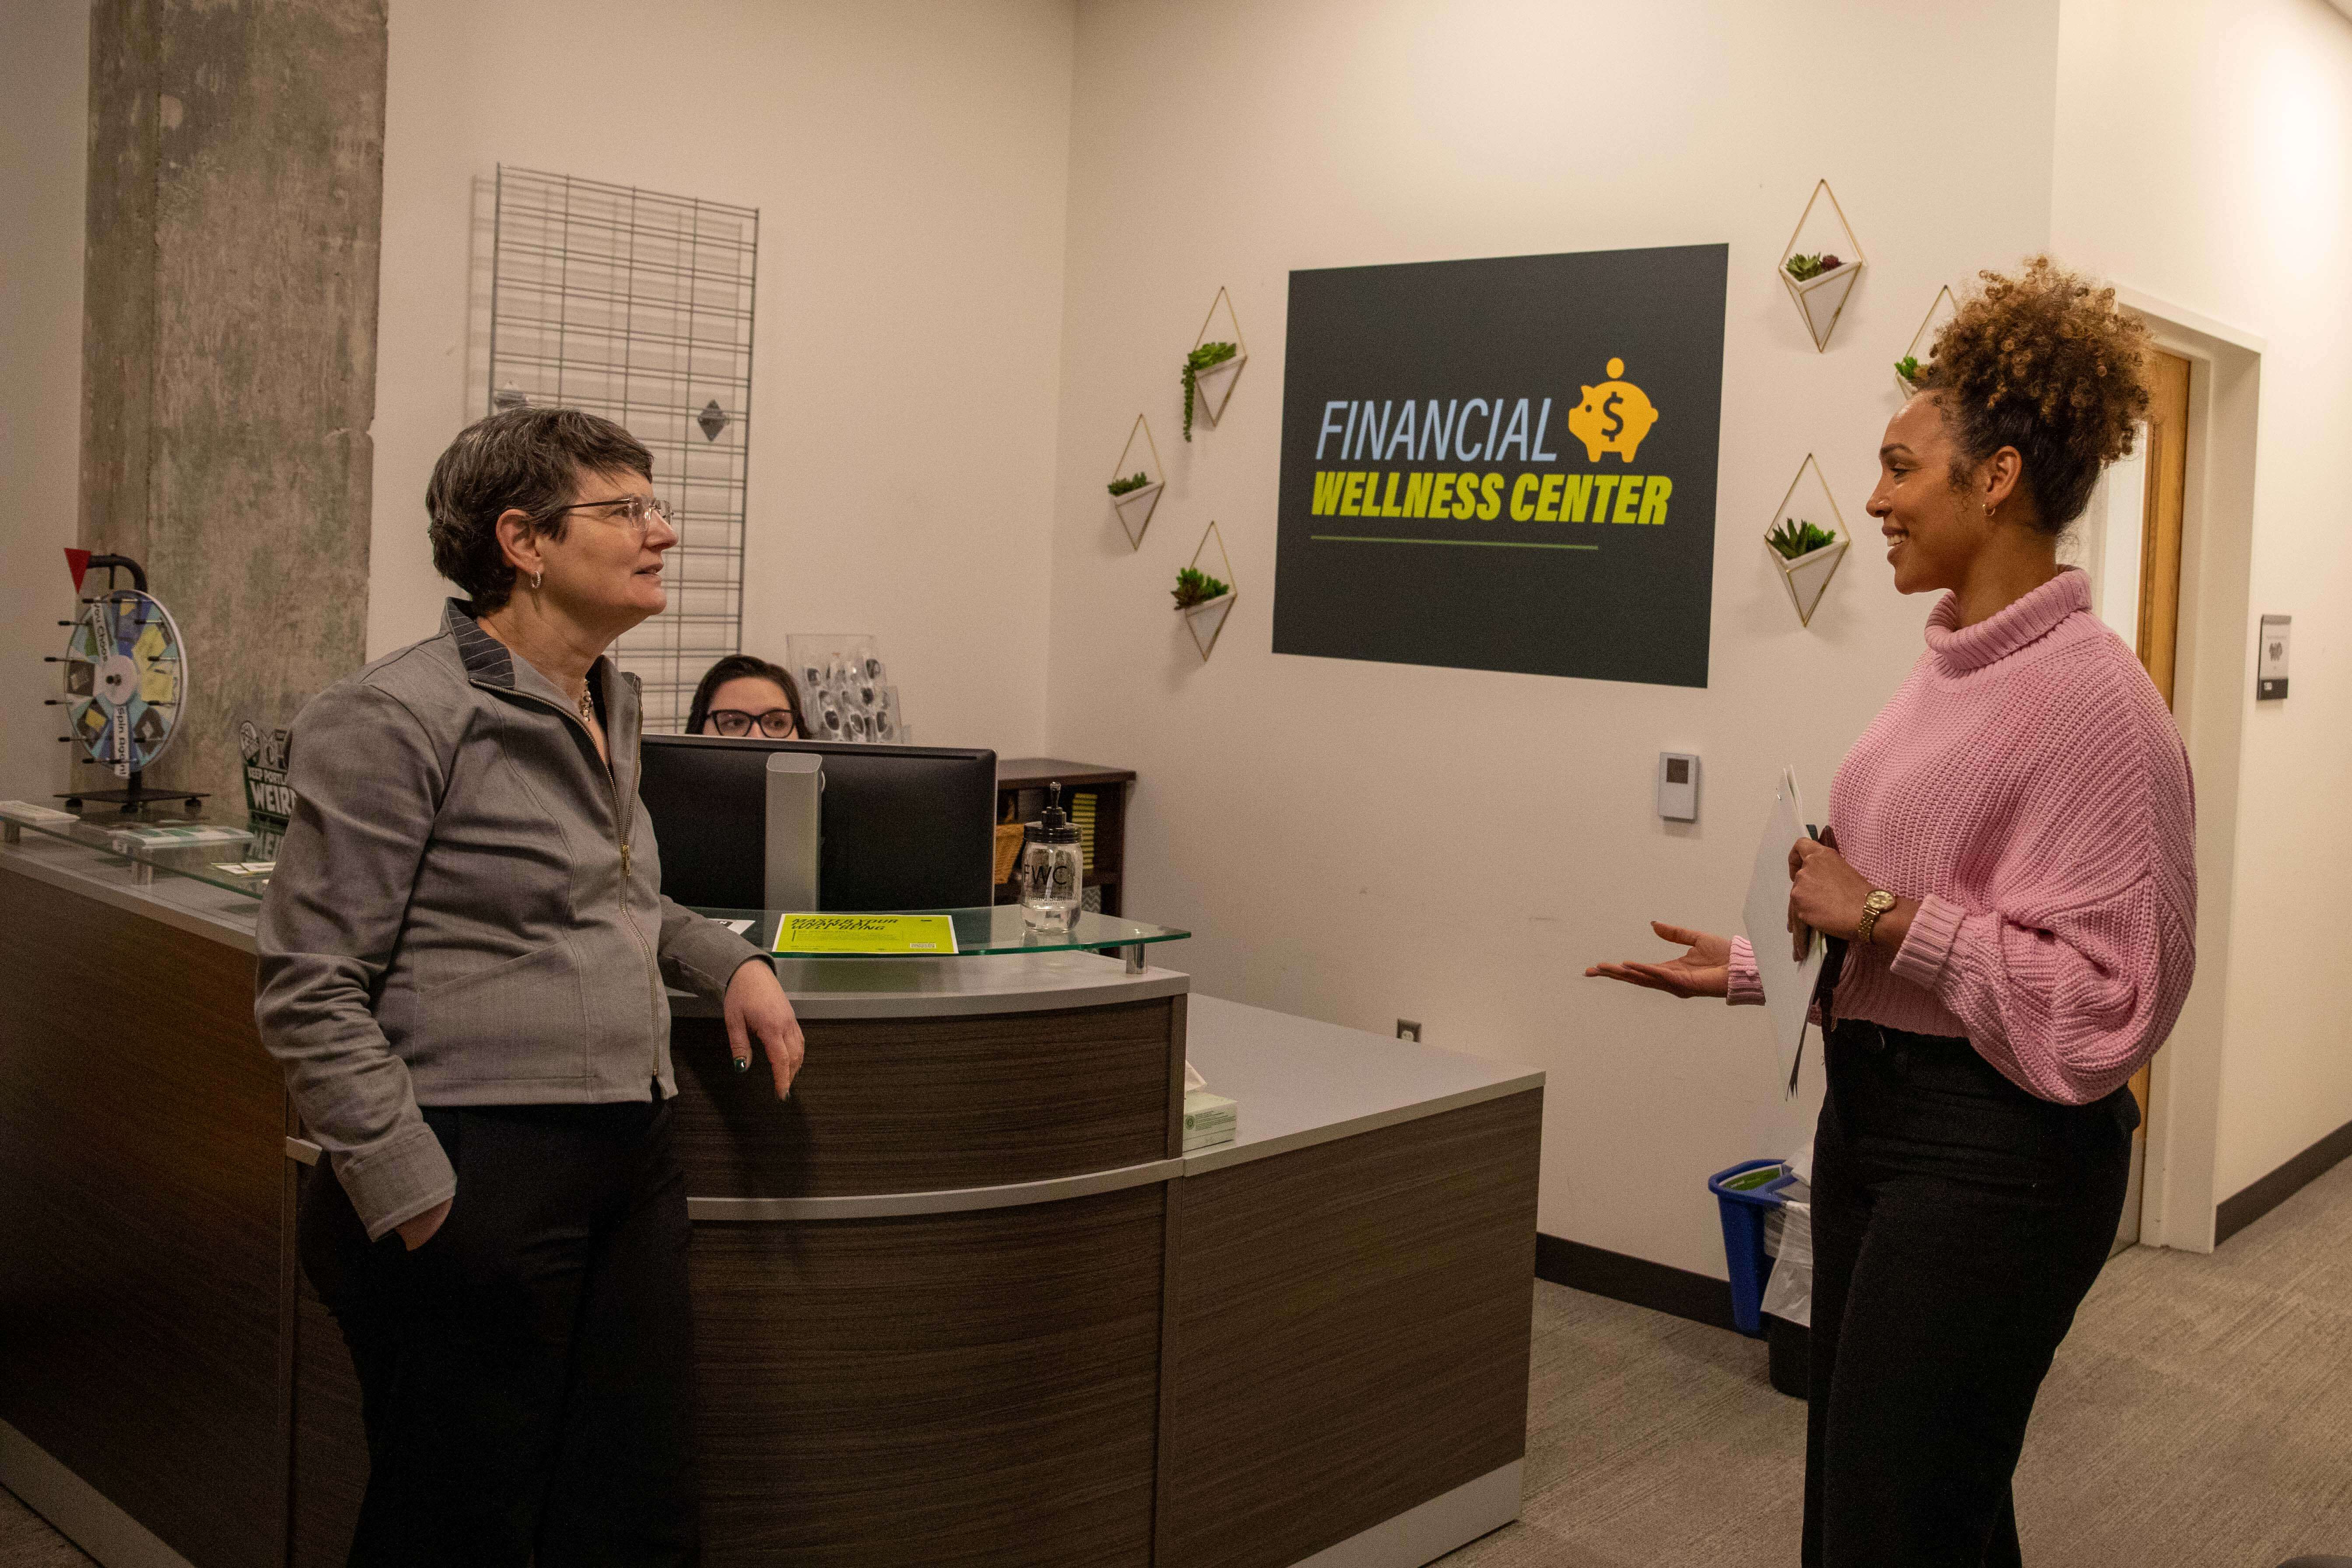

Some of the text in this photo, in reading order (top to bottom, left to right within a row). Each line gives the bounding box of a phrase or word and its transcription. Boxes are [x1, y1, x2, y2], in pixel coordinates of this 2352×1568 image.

[1316, 398, 1557, 462] FINANCIAL
[1602, 392, 1624, 442] $
[1312, 471, 1673, 525] WELLNESS CENTER
[97, 626, 108, 662] Choos
[117, 707, 126, 775] Spin Agan!
[264, 769, 287, 785] PORTL
[1024, 864, 1067, 885] FWC
